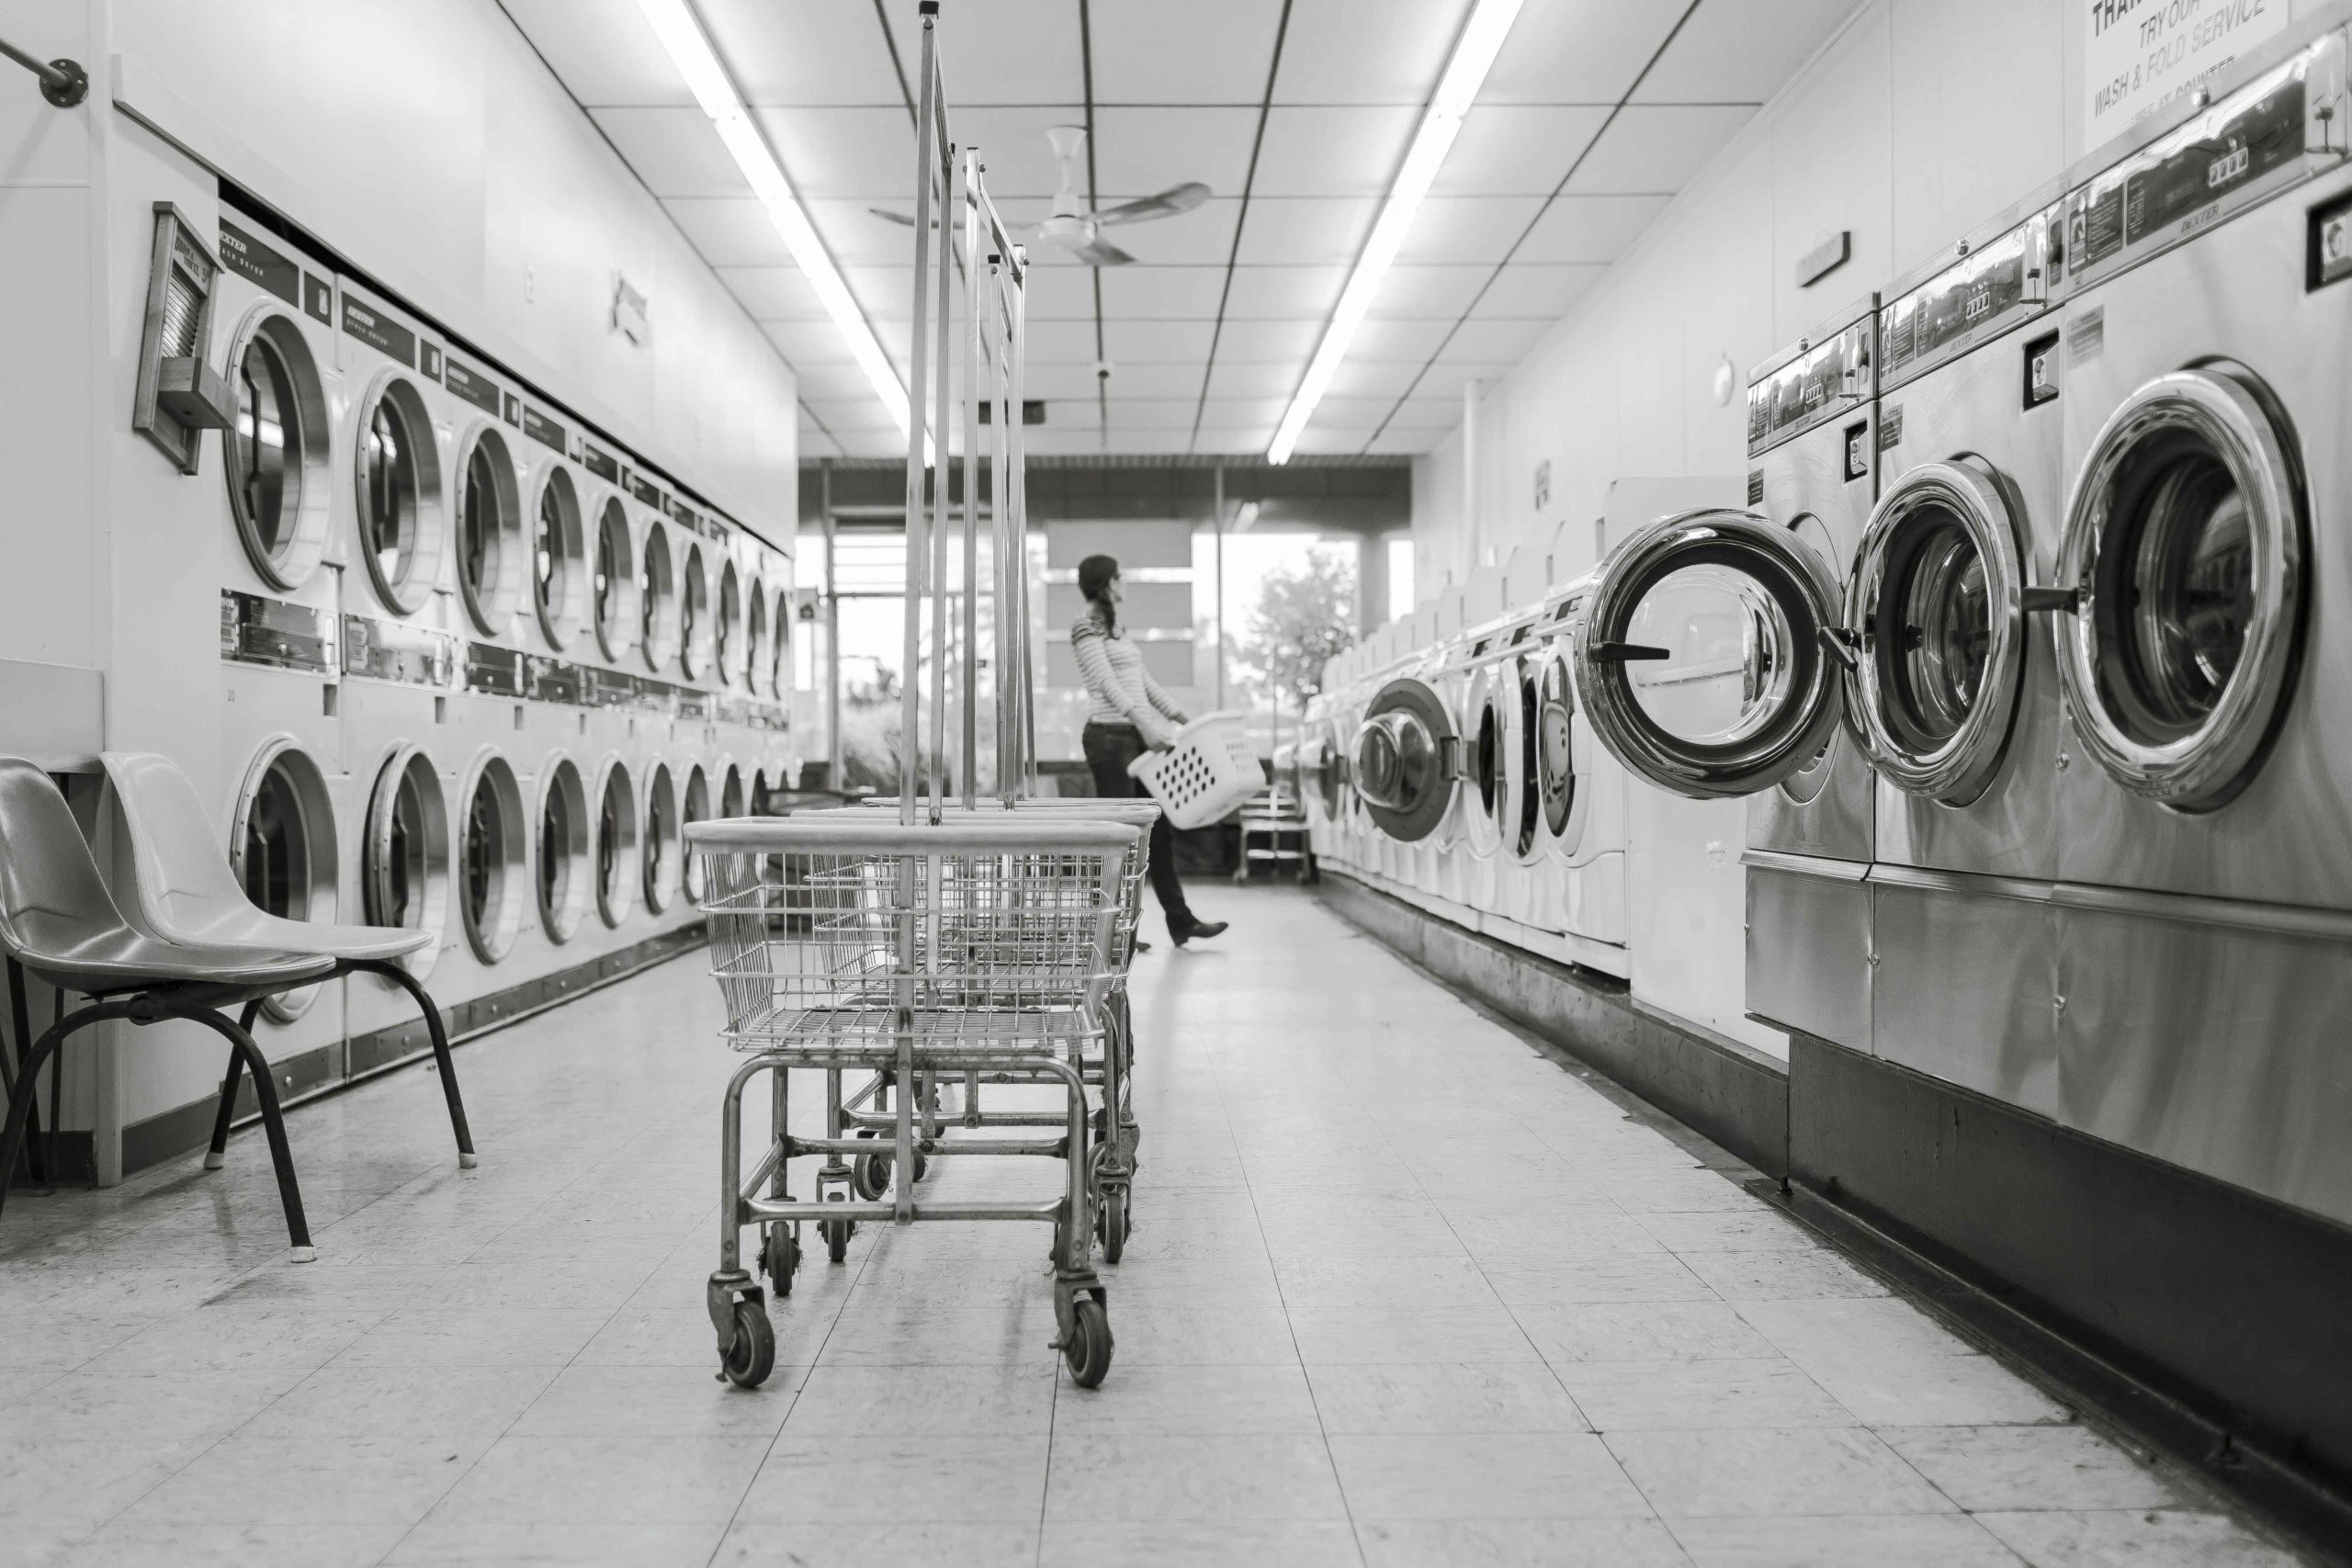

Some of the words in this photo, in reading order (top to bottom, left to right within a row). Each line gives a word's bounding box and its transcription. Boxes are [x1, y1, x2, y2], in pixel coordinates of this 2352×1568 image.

[2140, 6, 2167, 49] TRY
[2095, 72, 2129, 118] WASH
[2132, 63, 2142, 91] &
[2147, 34, 2186, 83] FOLD
[2191, 0, 2265, 52] SERVICE
[220, 231, 247, 254] EXTER
[227, 689, 235, 702] 20
